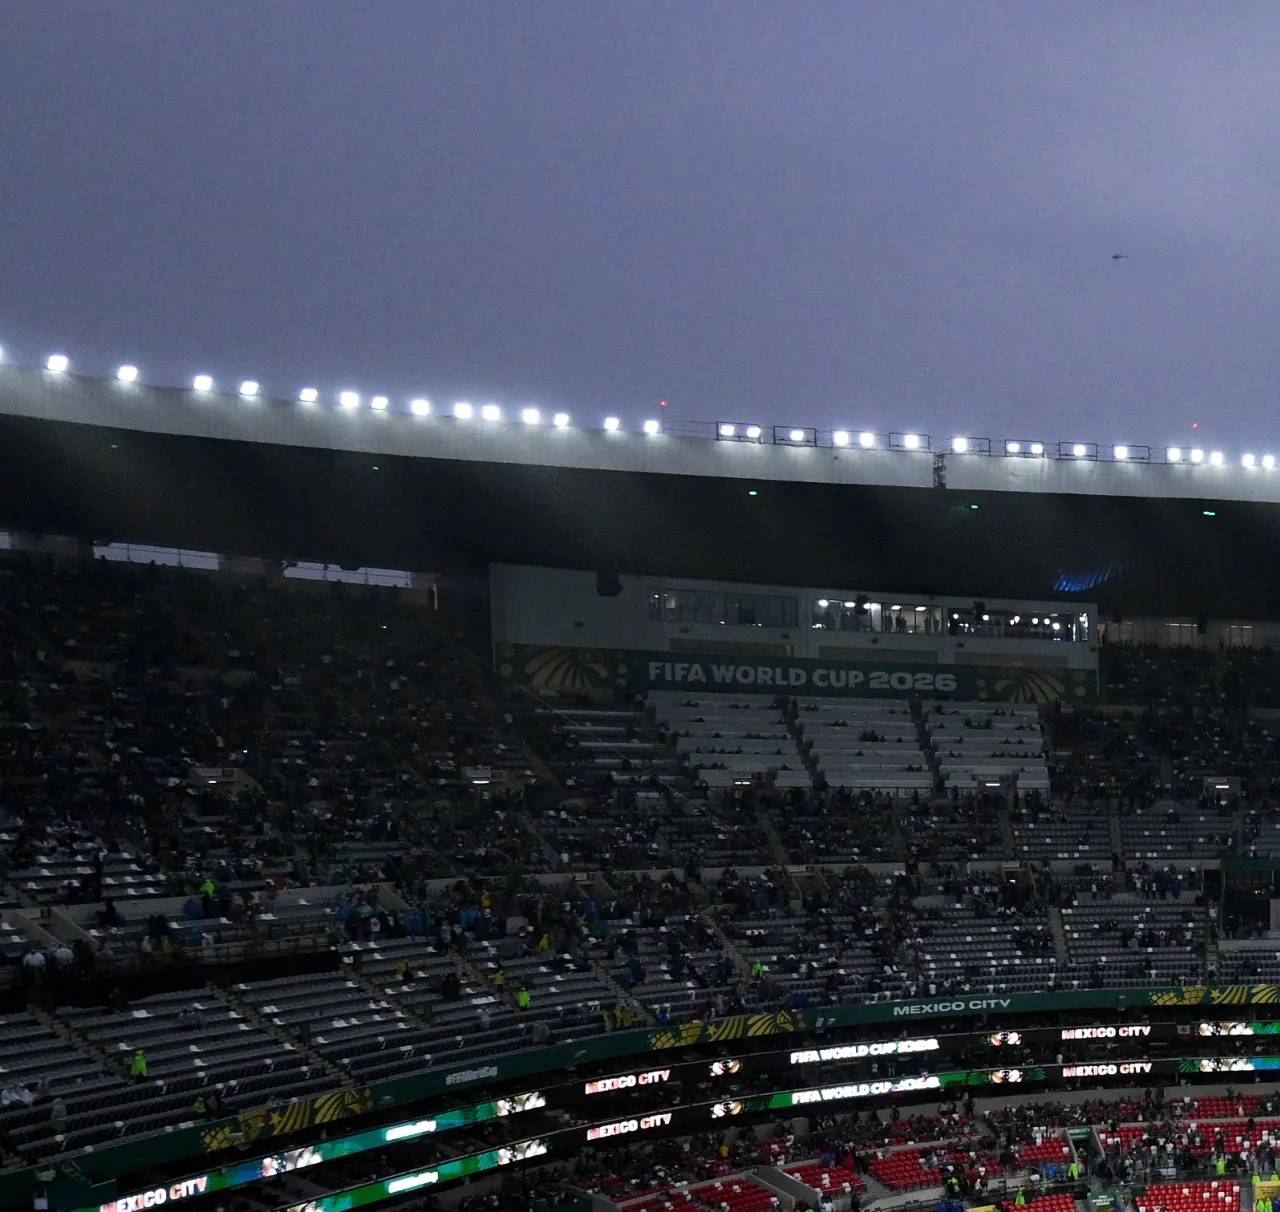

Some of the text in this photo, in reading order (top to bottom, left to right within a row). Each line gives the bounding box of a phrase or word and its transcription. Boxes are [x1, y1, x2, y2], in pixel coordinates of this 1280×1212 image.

[649, 662, 957, 692] FIFA WORLD CUP 2026
[893, 998, 1012, 1016] MEXICO CITY
[1062, 1027, 1116, 1040] MEXICO
[790, 1050, 820, 1064] FIFA
[820, 1045, 868, 1062] WORLD
[869, 1042, 897, 1056] CUP
[1063, 1064, 1117, 1077] MEXICO
[585, 1070, 670, 1095] MEXICO CITY
[792, 1092, 820, 1104] FIFA
[821, 1085, 869, 1100] WORLD
[587, 1114, 672, 1140] MEXICO CITY
[170, 1176, 208, 1200] CITY
